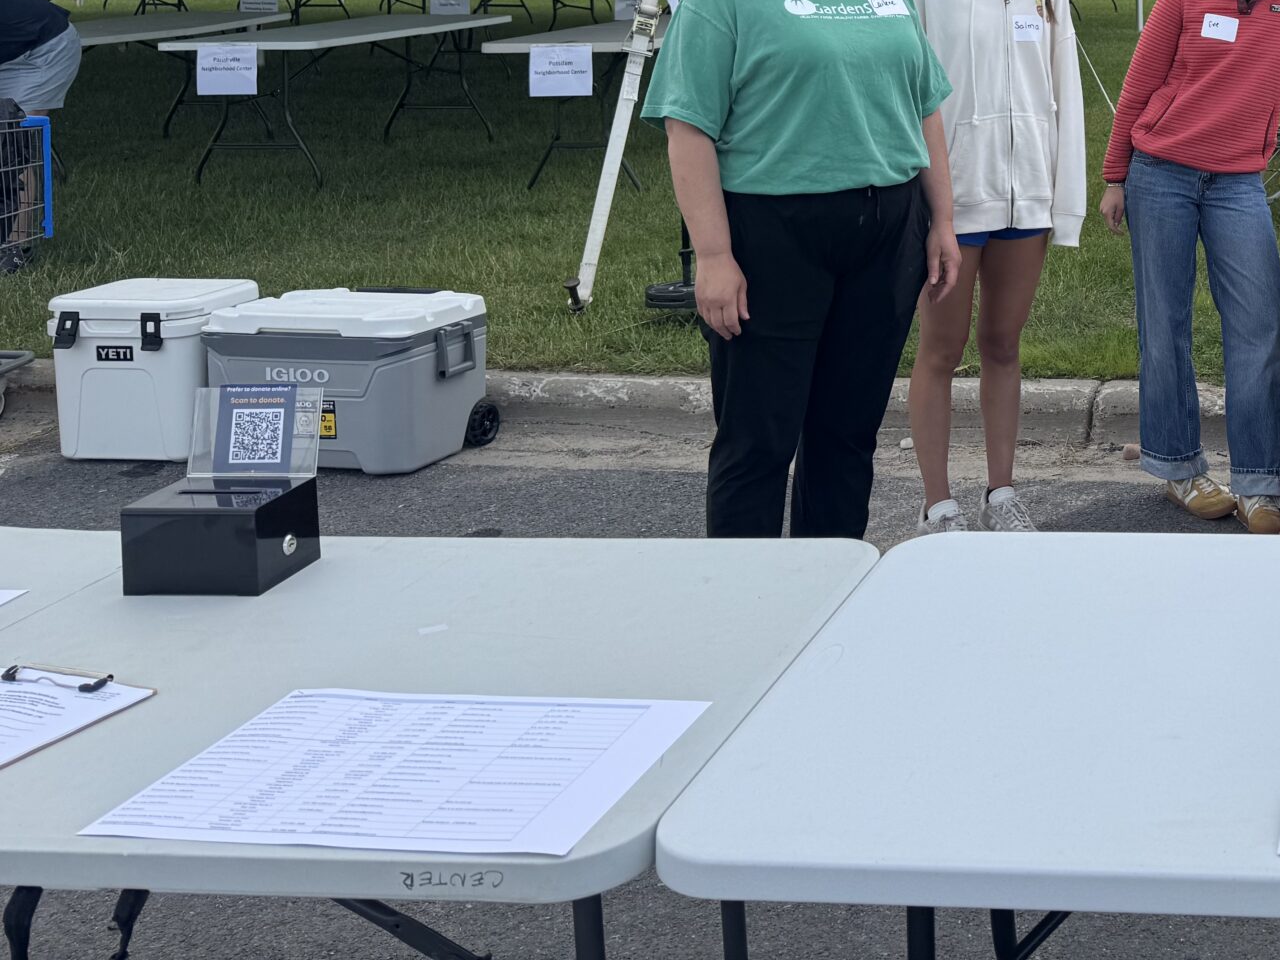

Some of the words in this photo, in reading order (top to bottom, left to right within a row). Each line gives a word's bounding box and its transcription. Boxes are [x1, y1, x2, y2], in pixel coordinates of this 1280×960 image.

[98, 348, 131, 359] YETI
[265, 367, 330, 383] IGLOO
[400, 870, 504, 890] CENTER
